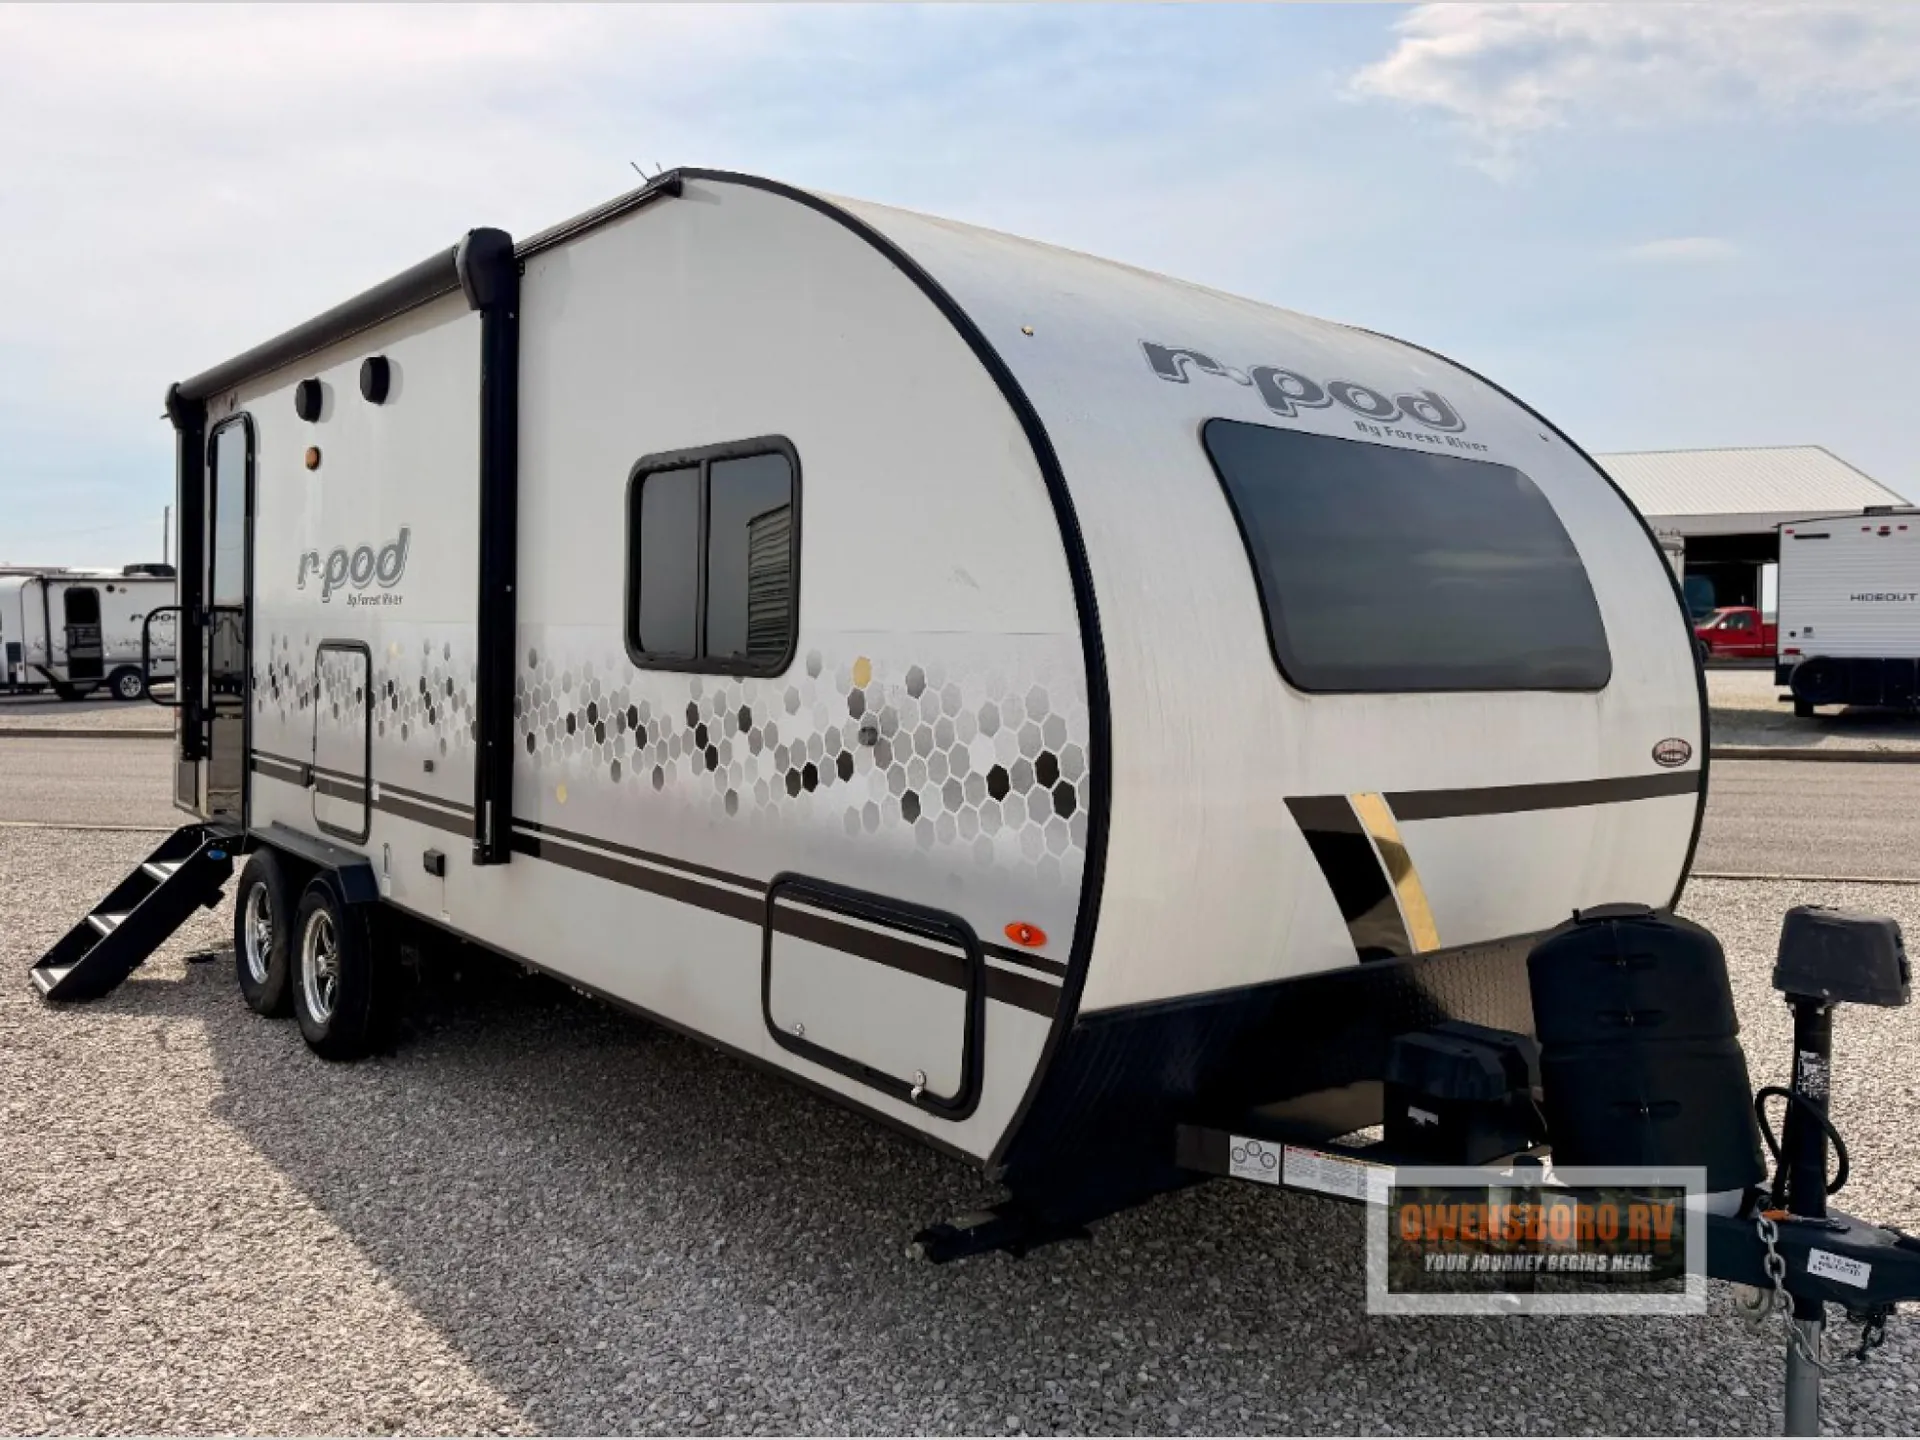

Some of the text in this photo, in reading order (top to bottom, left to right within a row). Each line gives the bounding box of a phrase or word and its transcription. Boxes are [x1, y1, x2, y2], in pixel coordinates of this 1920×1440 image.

[1384, 426, 1443, 444] Forest
[1444, 435, 1489, 452] River
[1850, 592, 1918, 602] HIDEOUT
